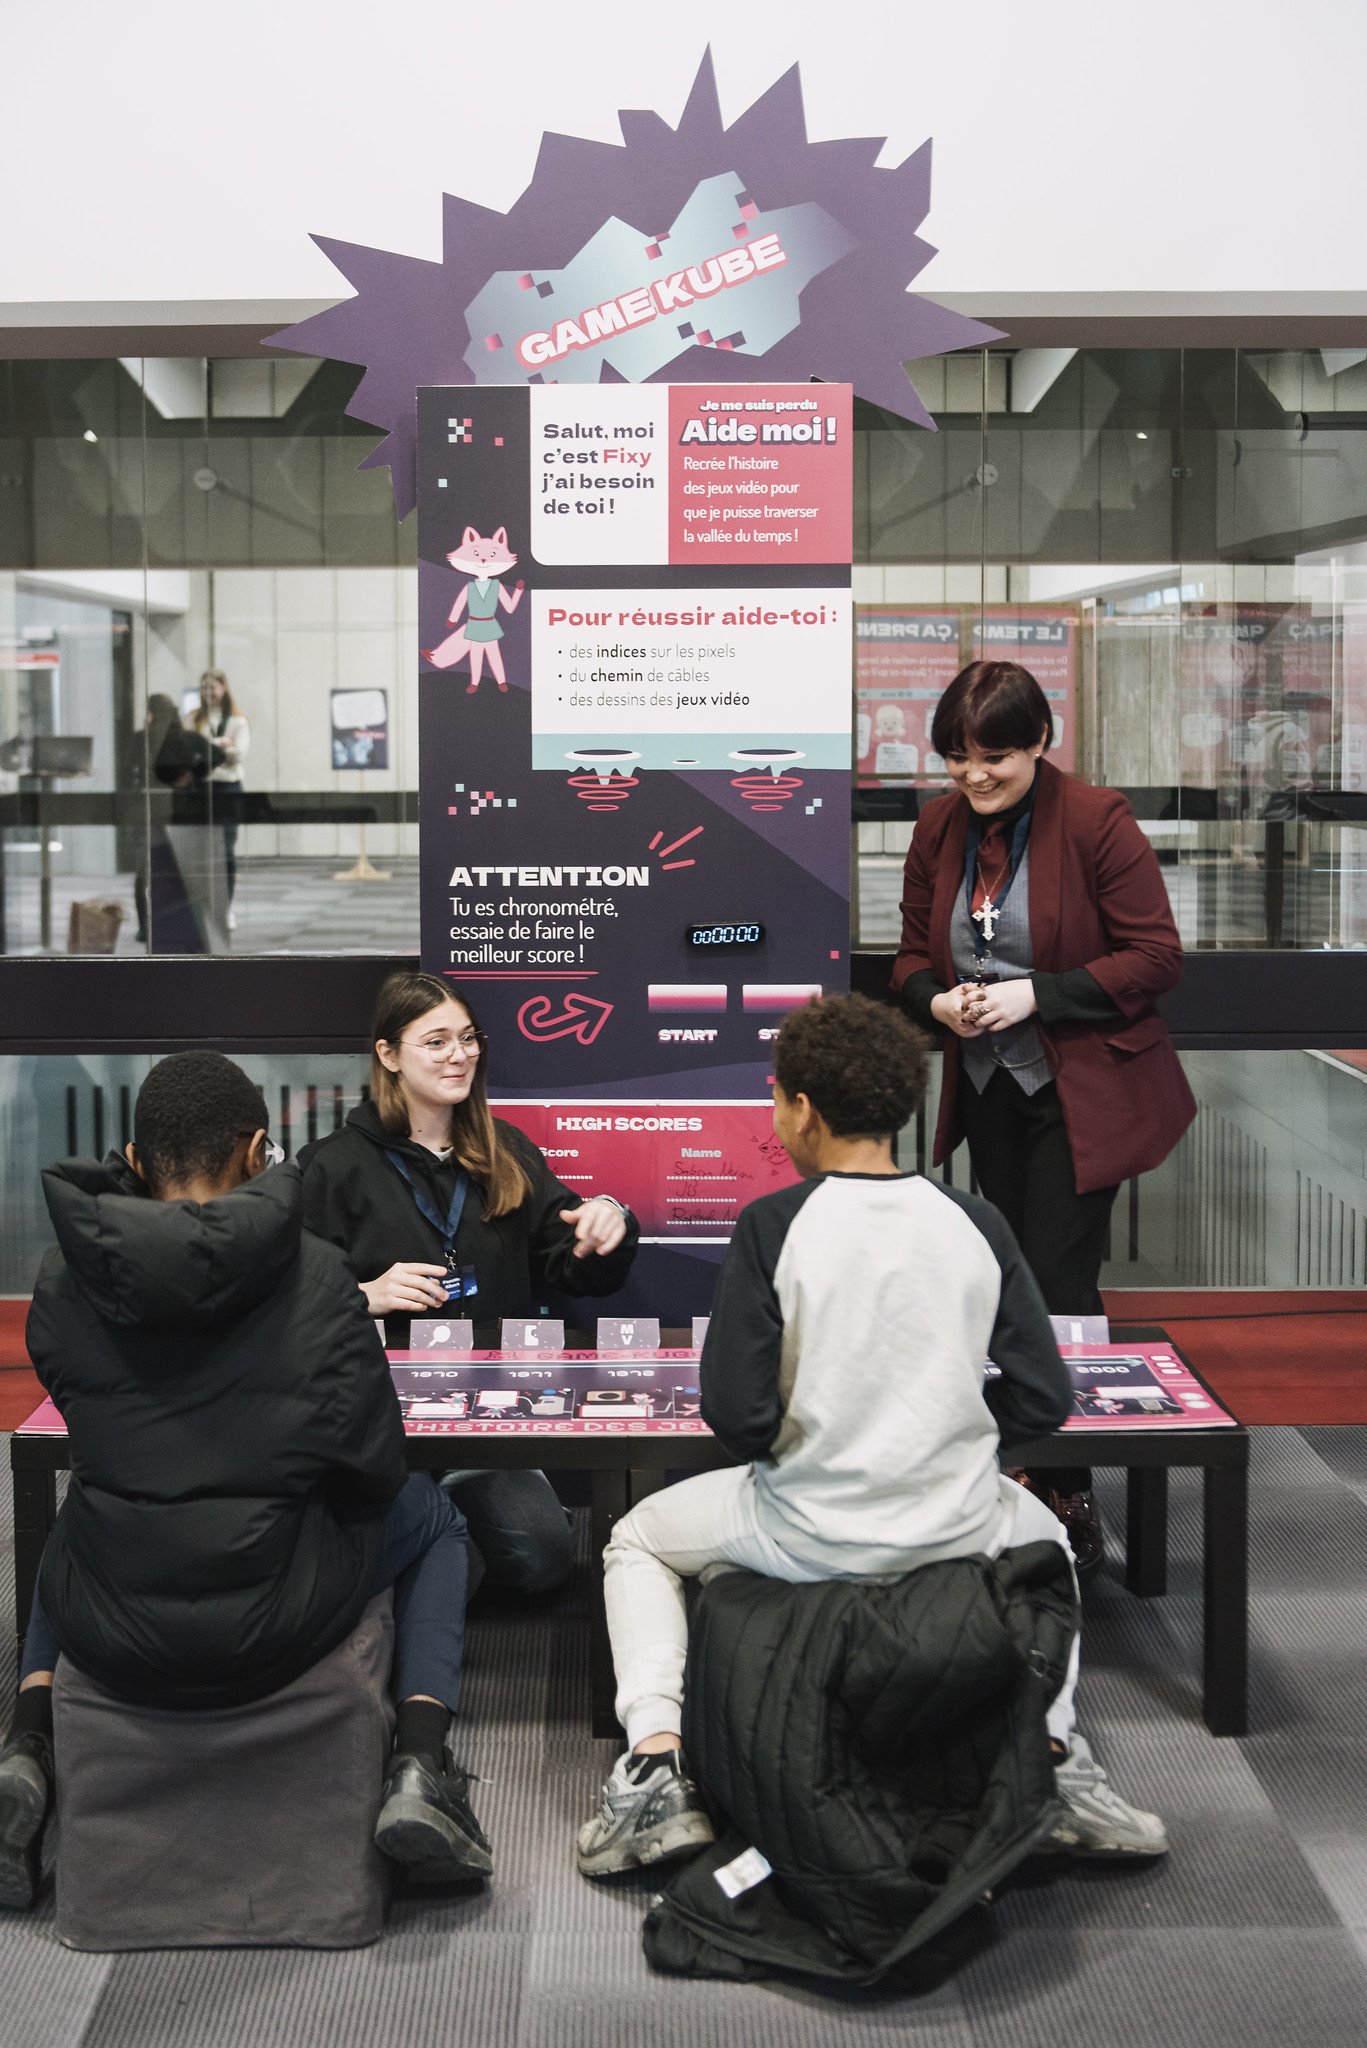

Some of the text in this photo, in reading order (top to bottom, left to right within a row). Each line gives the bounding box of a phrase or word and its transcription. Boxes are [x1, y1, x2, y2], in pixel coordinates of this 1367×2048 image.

[518, 233, 788, 366] GAME KUBE
[700, 399, 818, 413] Je me suis perdu
[544, 422, 653, 439] Salut, moi
[681, 417, 757, 443] Aide
[761, 416, 822, 443] moi
[544, 448, 651, 468] c’est Fixy
[684, 456, 778, 470] Recrée l'histoire
[542, 472, 654, 493] j’ai besoin
[684, 480, 800, 497] des jeux vidéo pour
[544, 499, 569, 514] de
[575, 498, 604, 514] toi
[684, 506, 819, 521] que je puisse traverser
[684, 529, 694, 542] la
[697, 529, 732, 542] vallée
[735, 529, 750, 542] du
[754, 530, 792, 545] temps
[549, 609, 612, 626] Pour
[619, 606, 715, 625] réussir
[722, 605, 825, 625] aide-toi
[570, 643, 735, 661] des indices sur les pixels
[570, 668, 709, 682] du chemin de câbles
[570, 692, 749, 709] des dessins des jeux vidéo
[449, 866, 649, 886] ATTENTION
[449, 897, 618, 917] Tu es chronométré,
[450, 920, 594, 939] essaie de faire le
[451, 944, 523, 963] meilleur
[528, 950, 574, 963] score
[658, 1029, 718, 1042] START
[758, 1028, 781, 1041] ST
[557, 1117, 703, 1132] HIGH SCORES
[539, 1147, 580, 1158] Score
[681, 1147, 723, 1158] Name
[584, 1422, 648, 1432] DES
